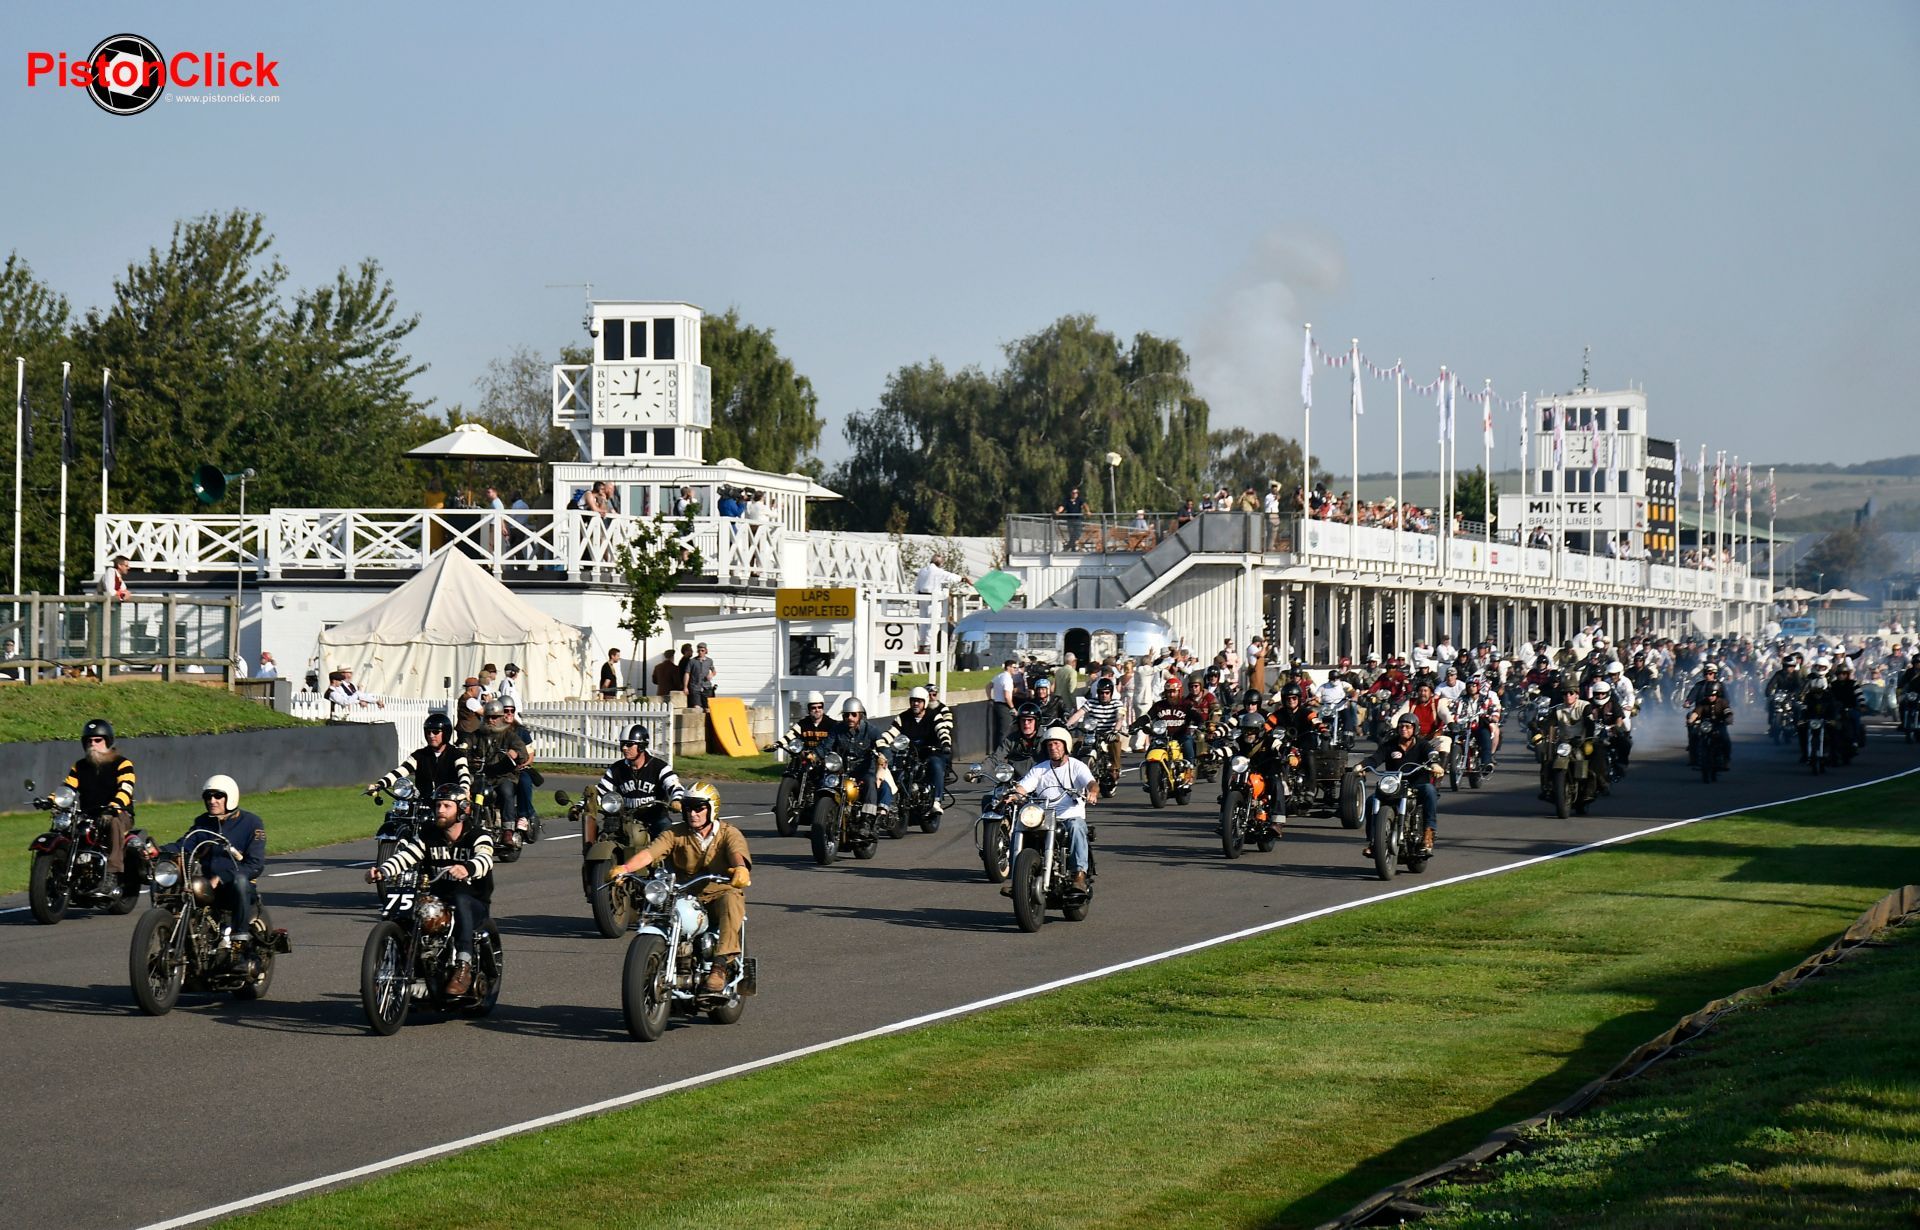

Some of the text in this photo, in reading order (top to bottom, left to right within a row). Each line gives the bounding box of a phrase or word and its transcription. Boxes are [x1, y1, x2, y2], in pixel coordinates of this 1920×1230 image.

[597, 370, 605, 418] ROLEX
[668, 370, 677, 418] ROLEX
[801, 590, 830, 602] LAPS
[782, 605, 849, 617] COMPLETED
[429, 846, 471, 861] HARLEY
[385, 893, 415, 911] 75
